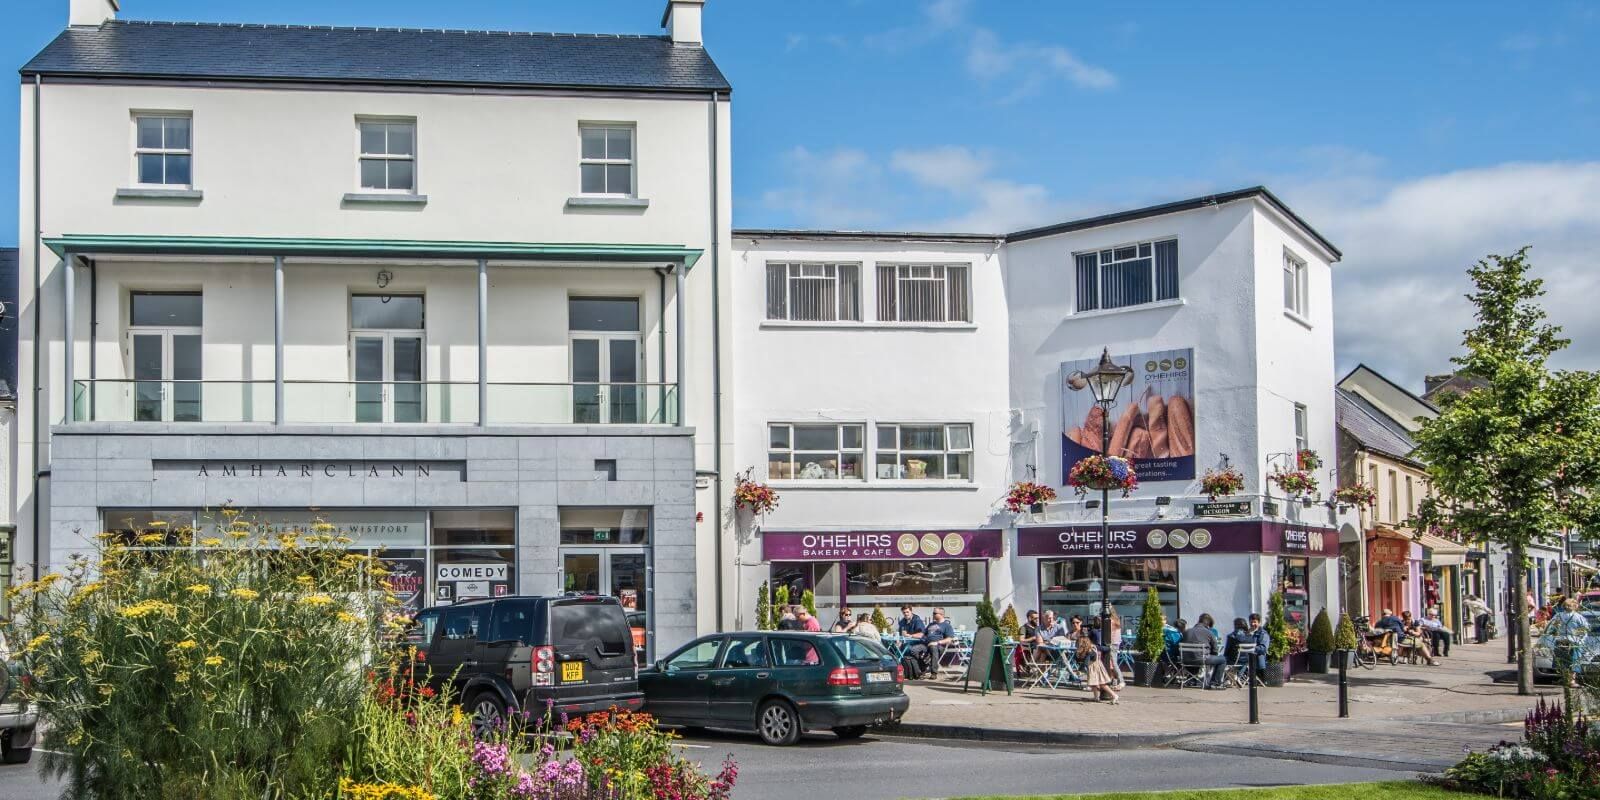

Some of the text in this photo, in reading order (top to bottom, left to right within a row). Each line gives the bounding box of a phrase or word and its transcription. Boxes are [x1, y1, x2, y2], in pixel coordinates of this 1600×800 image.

[197, 464, 431, 477] AMHARCLANN
[802, 534, 892, 548] O'HEHIRS
[1058, 530, 1137, 543] O'HEHIRS
[863, 548, 892, 556] CAFE
[439, 567, 505, 578] COMEDY
